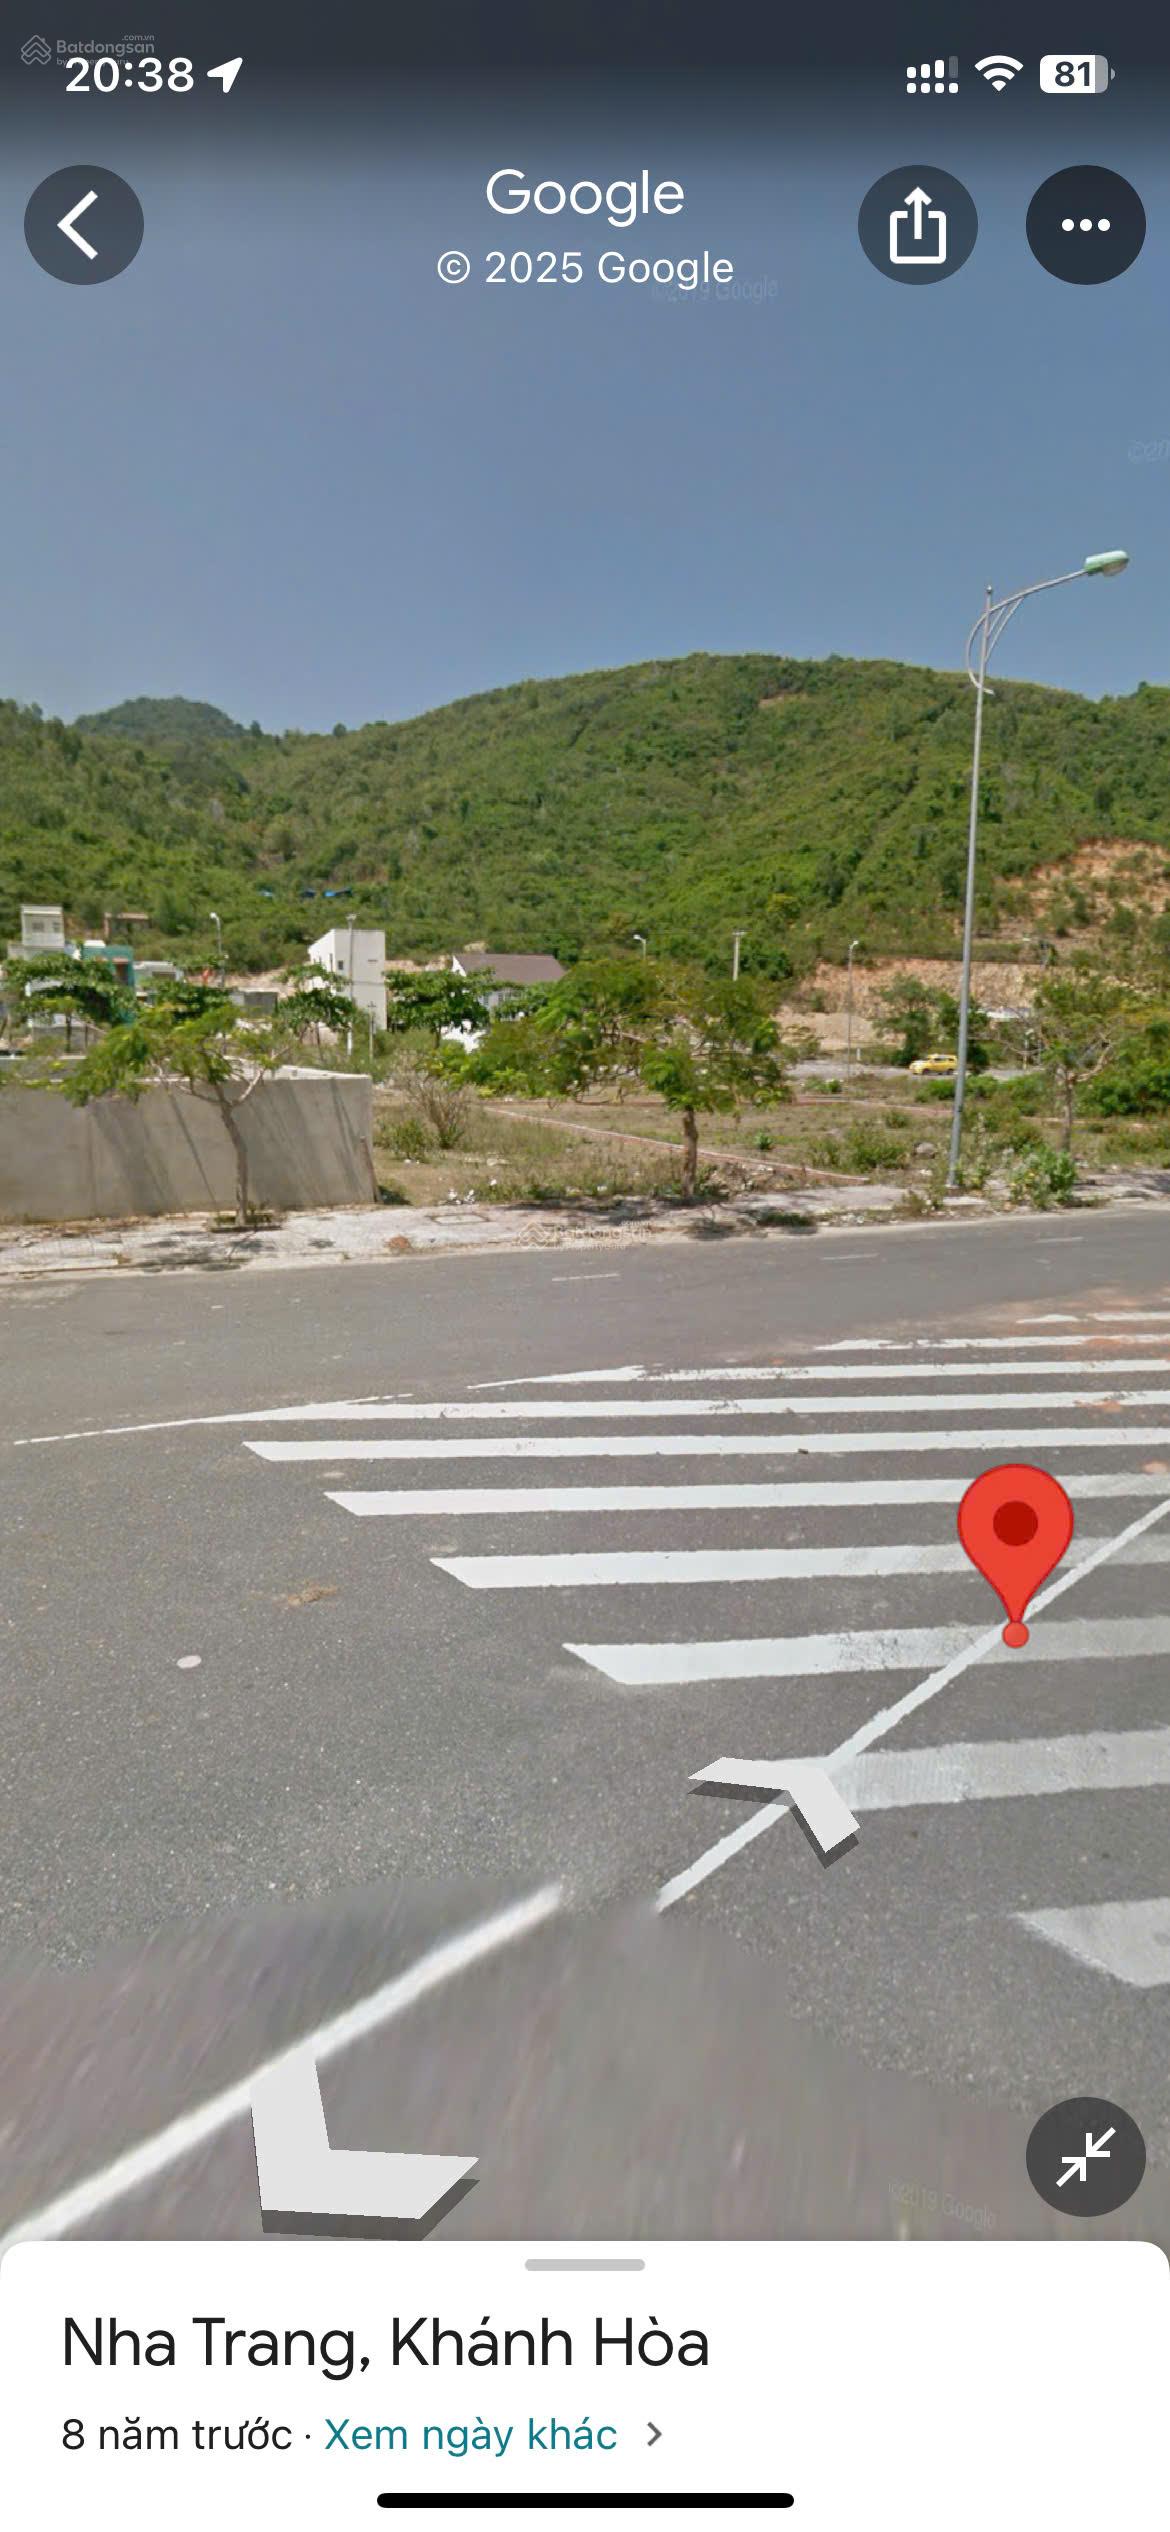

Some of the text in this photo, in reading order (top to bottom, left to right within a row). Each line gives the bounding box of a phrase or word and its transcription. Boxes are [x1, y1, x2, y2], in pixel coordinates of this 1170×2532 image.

[65, 56, 194, 93] 20:38
[1054, 61, 1090, 87] 81
[486, 168, 685, 228] Google
[485, 251, 583, 284] 2025
[598, 250, 734, 291] Google
[64, 2315, 709, 2381] Nha Trang, Khánh Hòa
[62, 2415, 617, 2458] 8 năm trước Xem ngày khác
